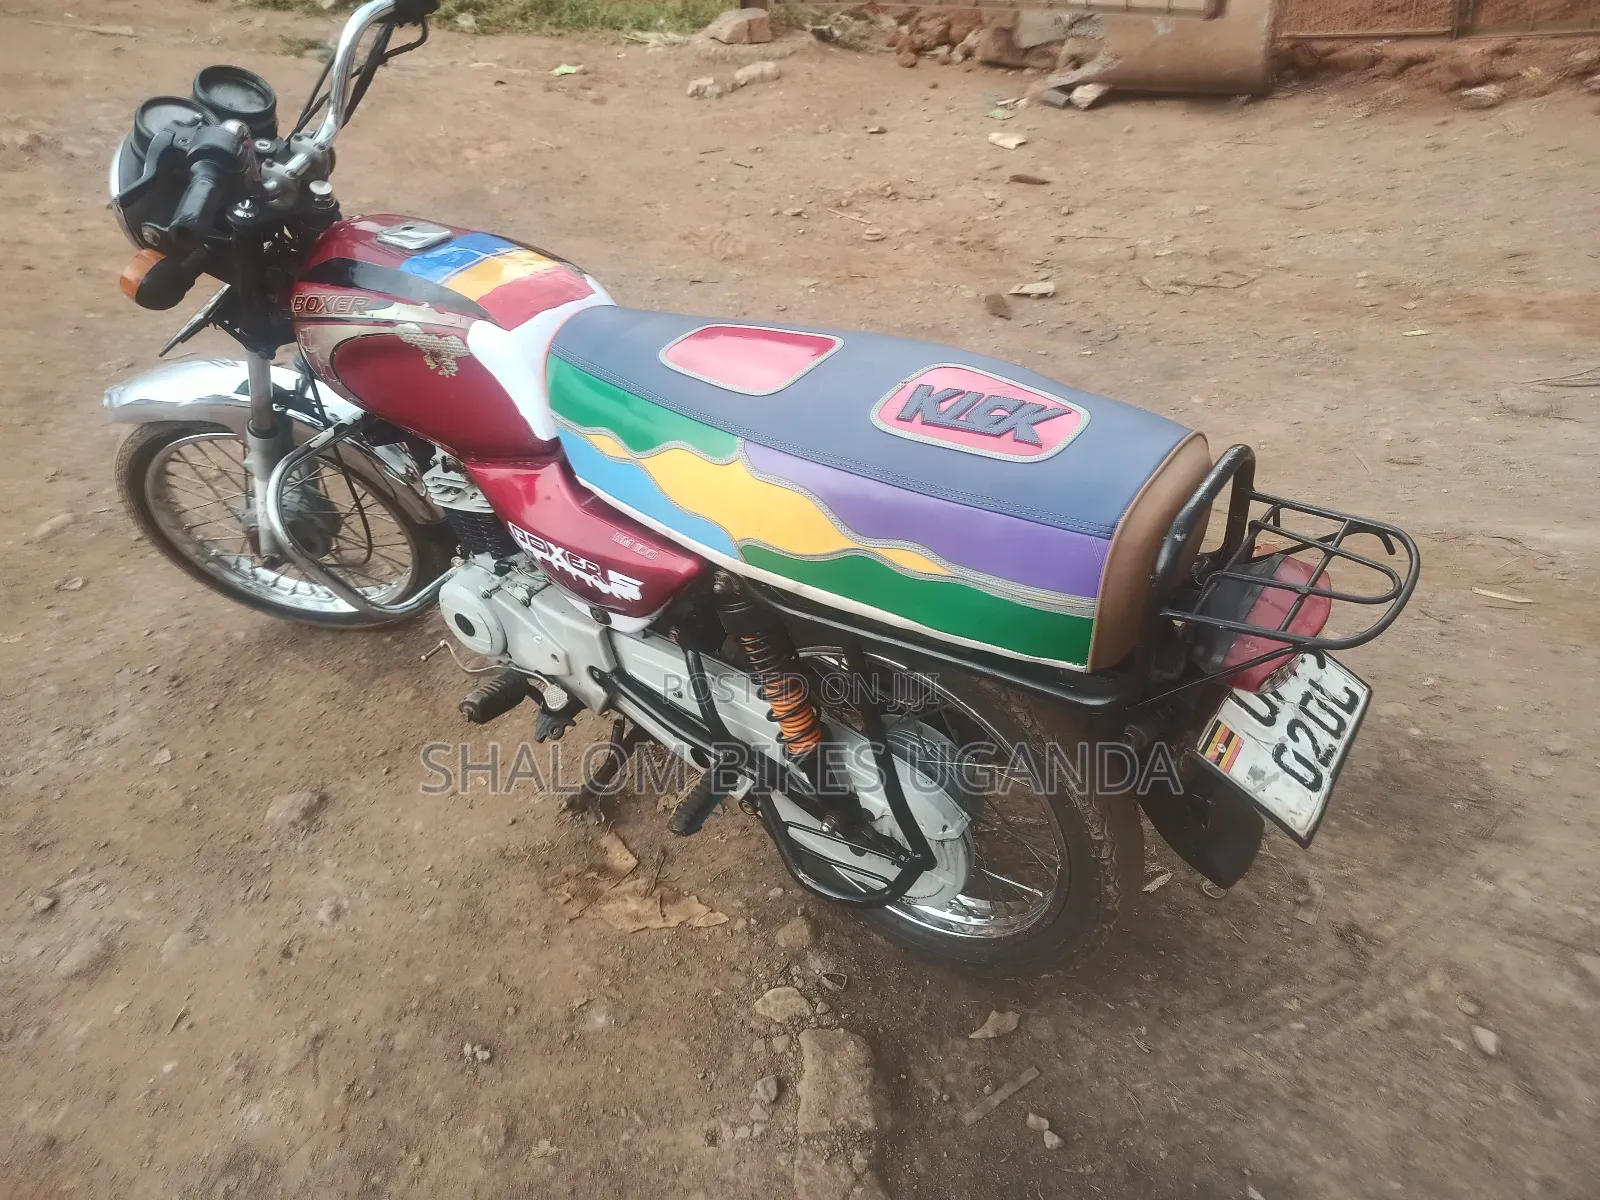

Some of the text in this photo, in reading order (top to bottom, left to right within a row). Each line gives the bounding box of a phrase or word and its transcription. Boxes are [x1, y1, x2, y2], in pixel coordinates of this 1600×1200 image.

[291, 292, 371, 315] BOXER
[896, 384, 1072, 448] KICK
[507, 521, 606, 584] BOXER
[633, 543, 659, 560] 100
